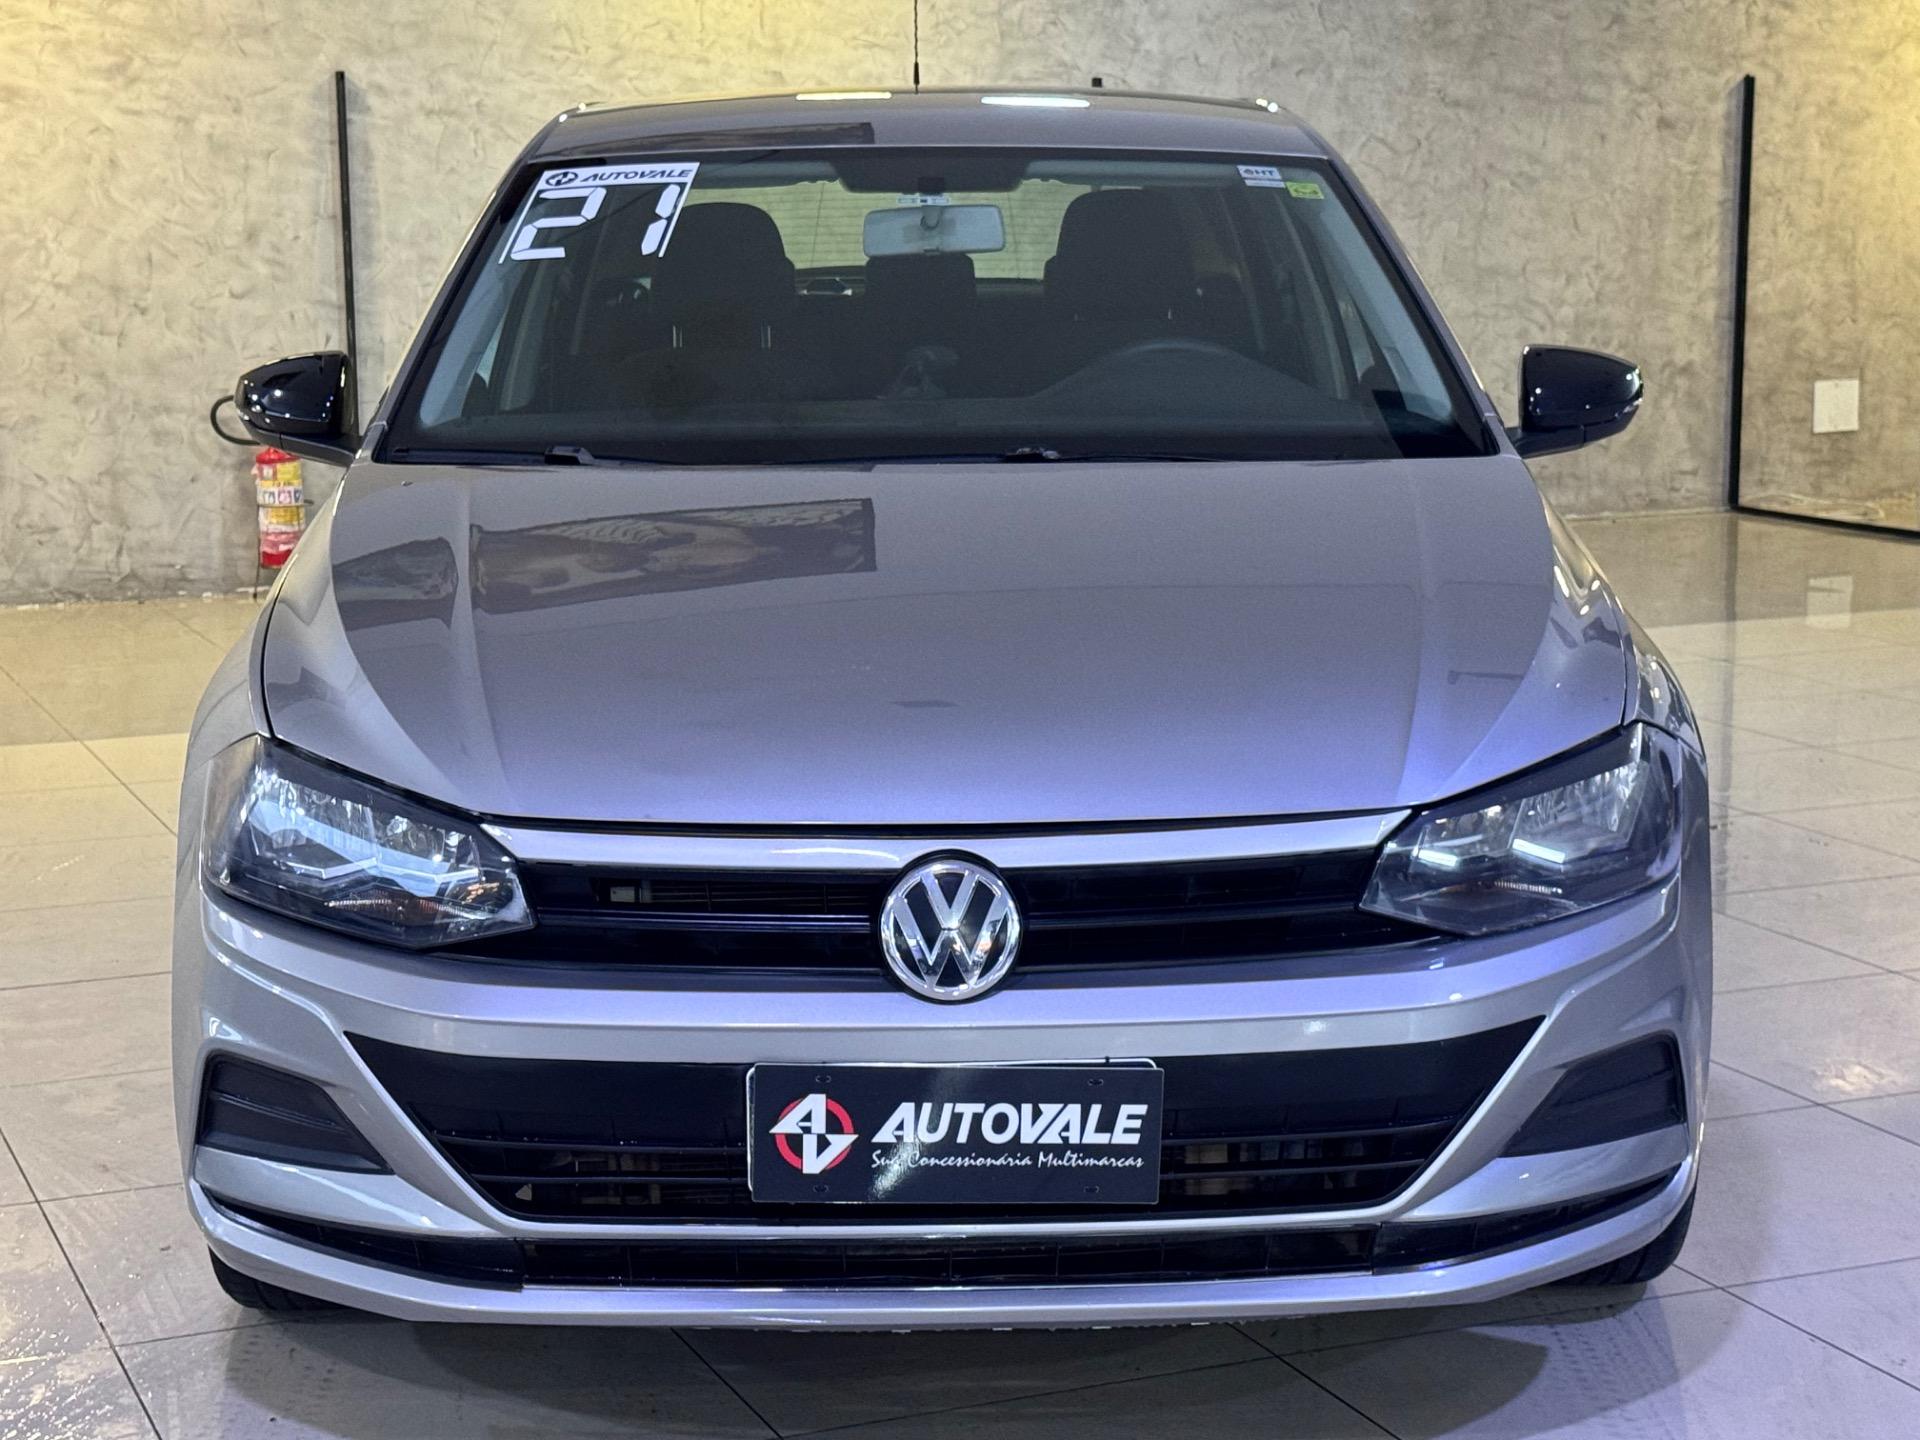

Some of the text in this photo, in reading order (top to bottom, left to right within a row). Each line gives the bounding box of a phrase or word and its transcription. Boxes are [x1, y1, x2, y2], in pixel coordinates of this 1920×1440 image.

[582, 169, 693, 182] AUTOVALE
[510, 184, 681, 261] 21
[871, 1102, 1148, 1145] AUTOVALE
[871, 1149, 1145, 1168] Sua Concessionária Multimarcas
